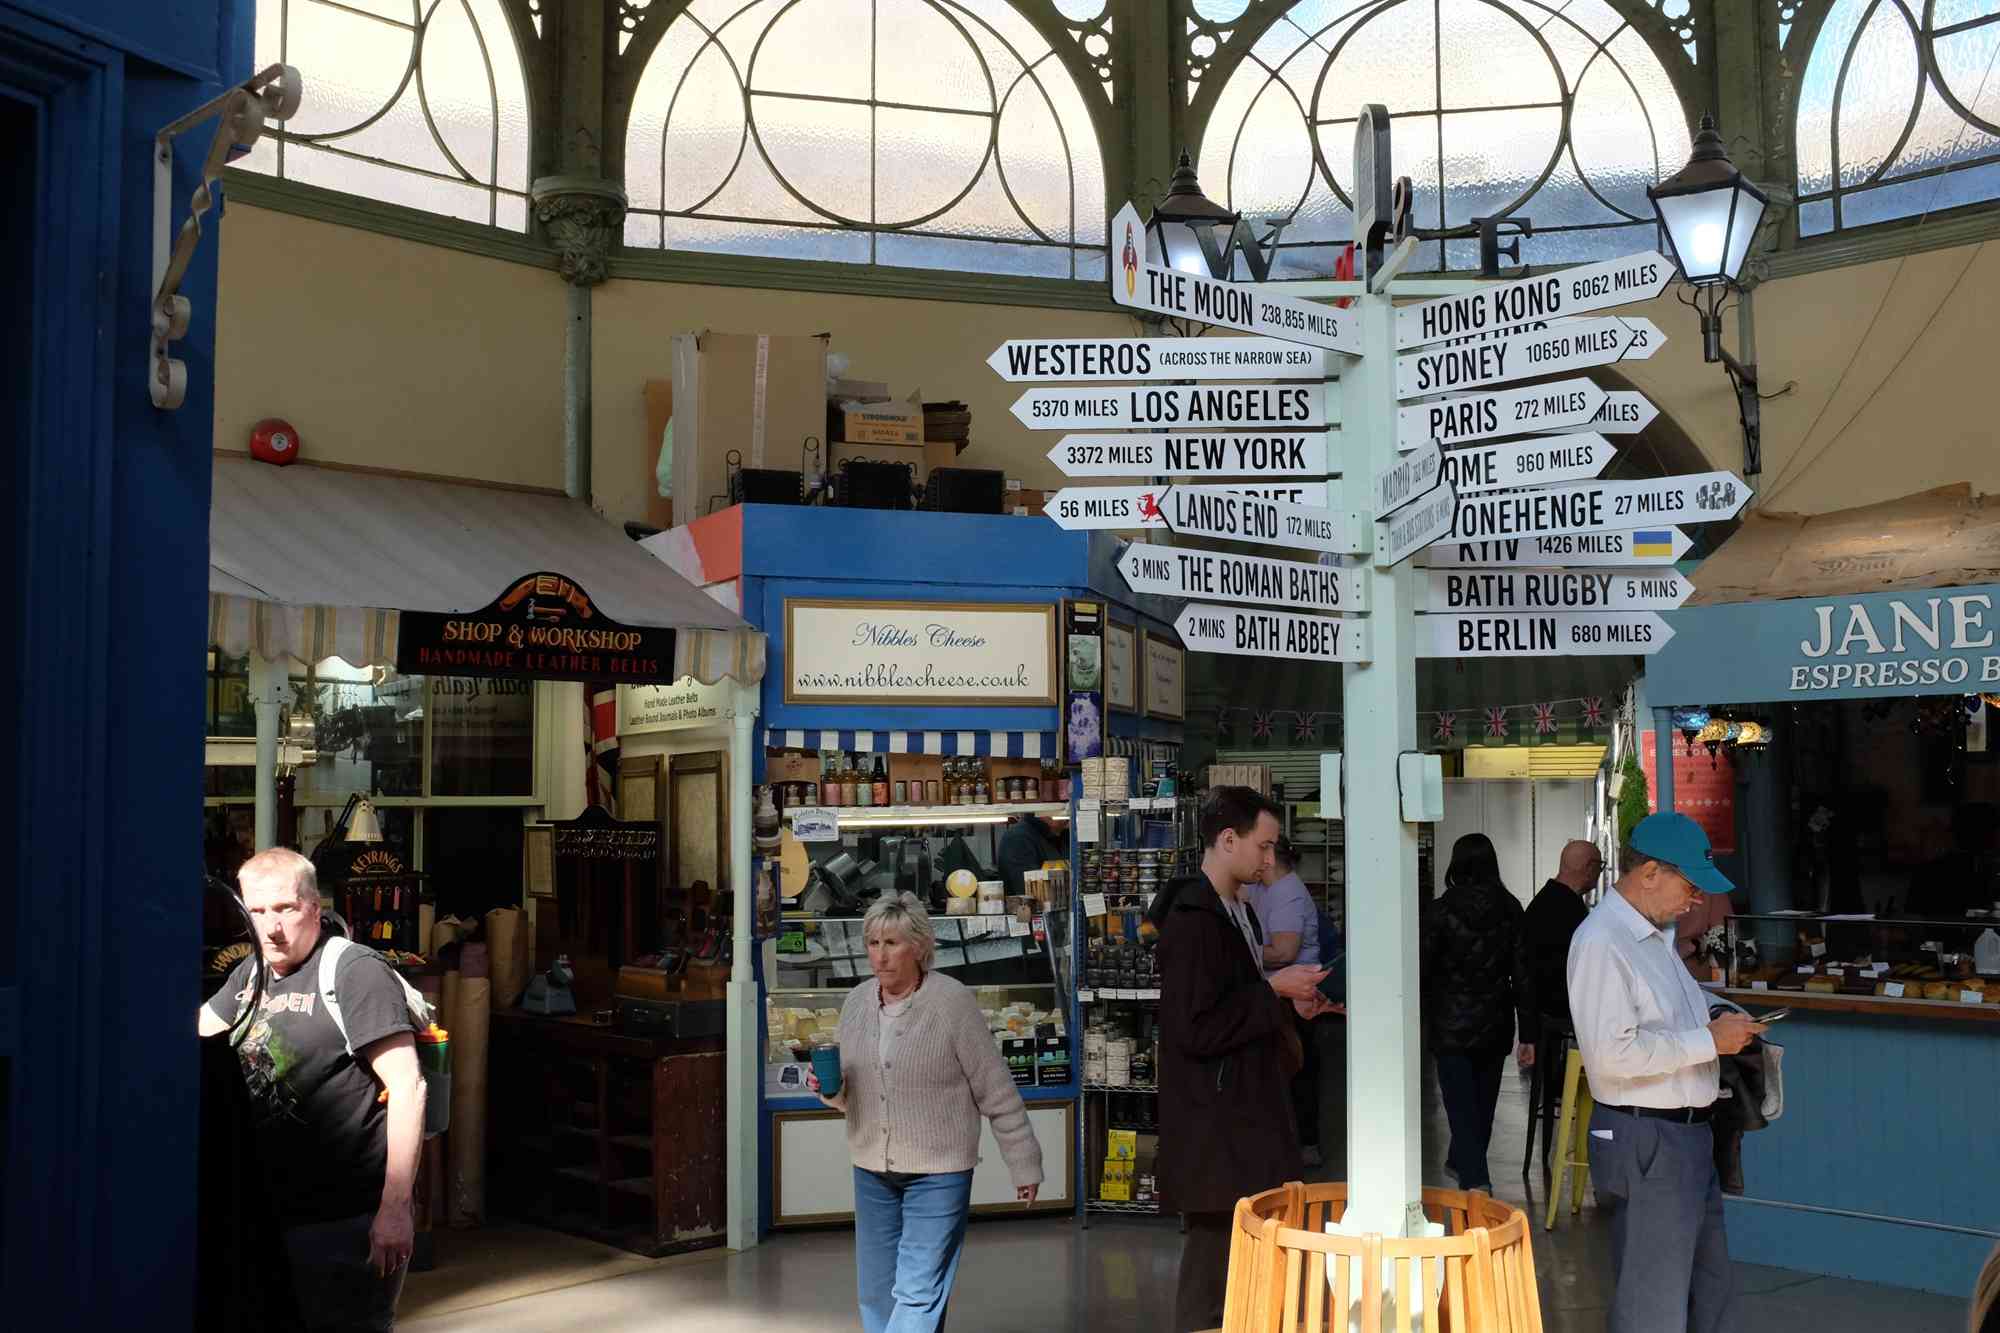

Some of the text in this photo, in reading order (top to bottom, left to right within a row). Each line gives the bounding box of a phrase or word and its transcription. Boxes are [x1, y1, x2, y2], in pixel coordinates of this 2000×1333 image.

[1146, 269, 1338, 338] THE MOON 238,855 MILES
[1422, 295, 1486, 339] HONG
[1495, 278, 1561, 325] KONG
[1573, 276, 1609, 301] 6062
[1614, 264, 1657, 292] MILES
[1007, 343, 1312, 376] WESTEROS (ACROSS THE NARROW SEA)
[1417, 343, 1508, 390] SYDNEY
[1525, 338, 1569, 363] 10650
[1575, 329, 1618, 352] MILES
[1032, 389, 1310, 423] 5370 MILES LOS ANGELES
[1430, 391, 1586, 440] PARIS 272 MILES
[1067, 438, 1306, 470] 3372 MILES NEW YORK
[1443, 450, 1498, 490] OME
[1516, 455, 1544, 474] 960
[1550, 446, 1594, 470] MILES
[1060, 500, 1129, 518] 56 MILES
[1176, 491, 1237, 534] LANDS
[1243, 501, 1278, 539] END
[1286, 516, 1302, 536] 172
[1305, 518, 1332, 540] MILES
[1454, 490, 1604, 537] ONEHENGE
[1615, 496, 1633, 516] 27
[1637, 490, 1684, 513] MILES
[1536, 536, 1572, 554] 1426
[1578, 535, 1622, 554] MILES
[1132, 555, 1340, 605] 3 MINS THE ROMAN BATHS
[1447, 573, 1678, 607] BATH RUGBY 5 MINS
[443, 620, 642, 653] SHOP & WORKSHOP
[851, 623, 986, 648] Nibbles Cheese
[1189, 614, 1341, 656] 2 MINS BATH ABBEY
[1458, 618, 1652, 651] BERLIN 680 MILES
[419, 646, 658, 673] HANDMADE LEATHER BELTS
[797, 663, 1030, 688] www.nibblescheese.co.uk
[1789, 657, 1969, 690] ESPRESSO
[352, 850, 404, 873] KEYRINGS
